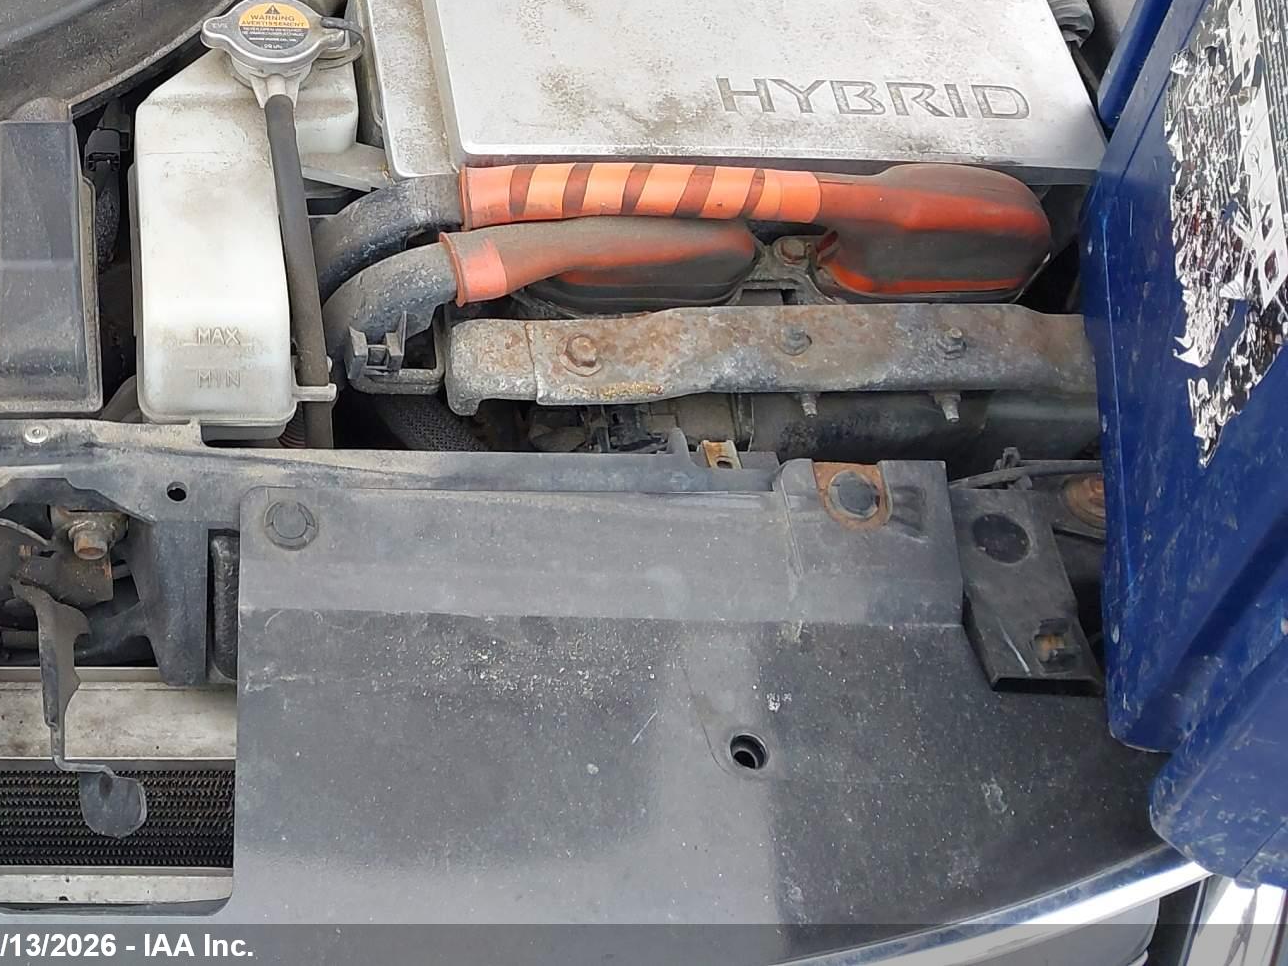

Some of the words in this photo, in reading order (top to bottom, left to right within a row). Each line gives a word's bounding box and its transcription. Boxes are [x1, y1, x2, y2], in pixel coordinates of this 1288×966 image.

[715, 77, 1030, 120] HYBRID
[196, 326, 241, 345] MAX
[197, 369, 241, 388] MIN
